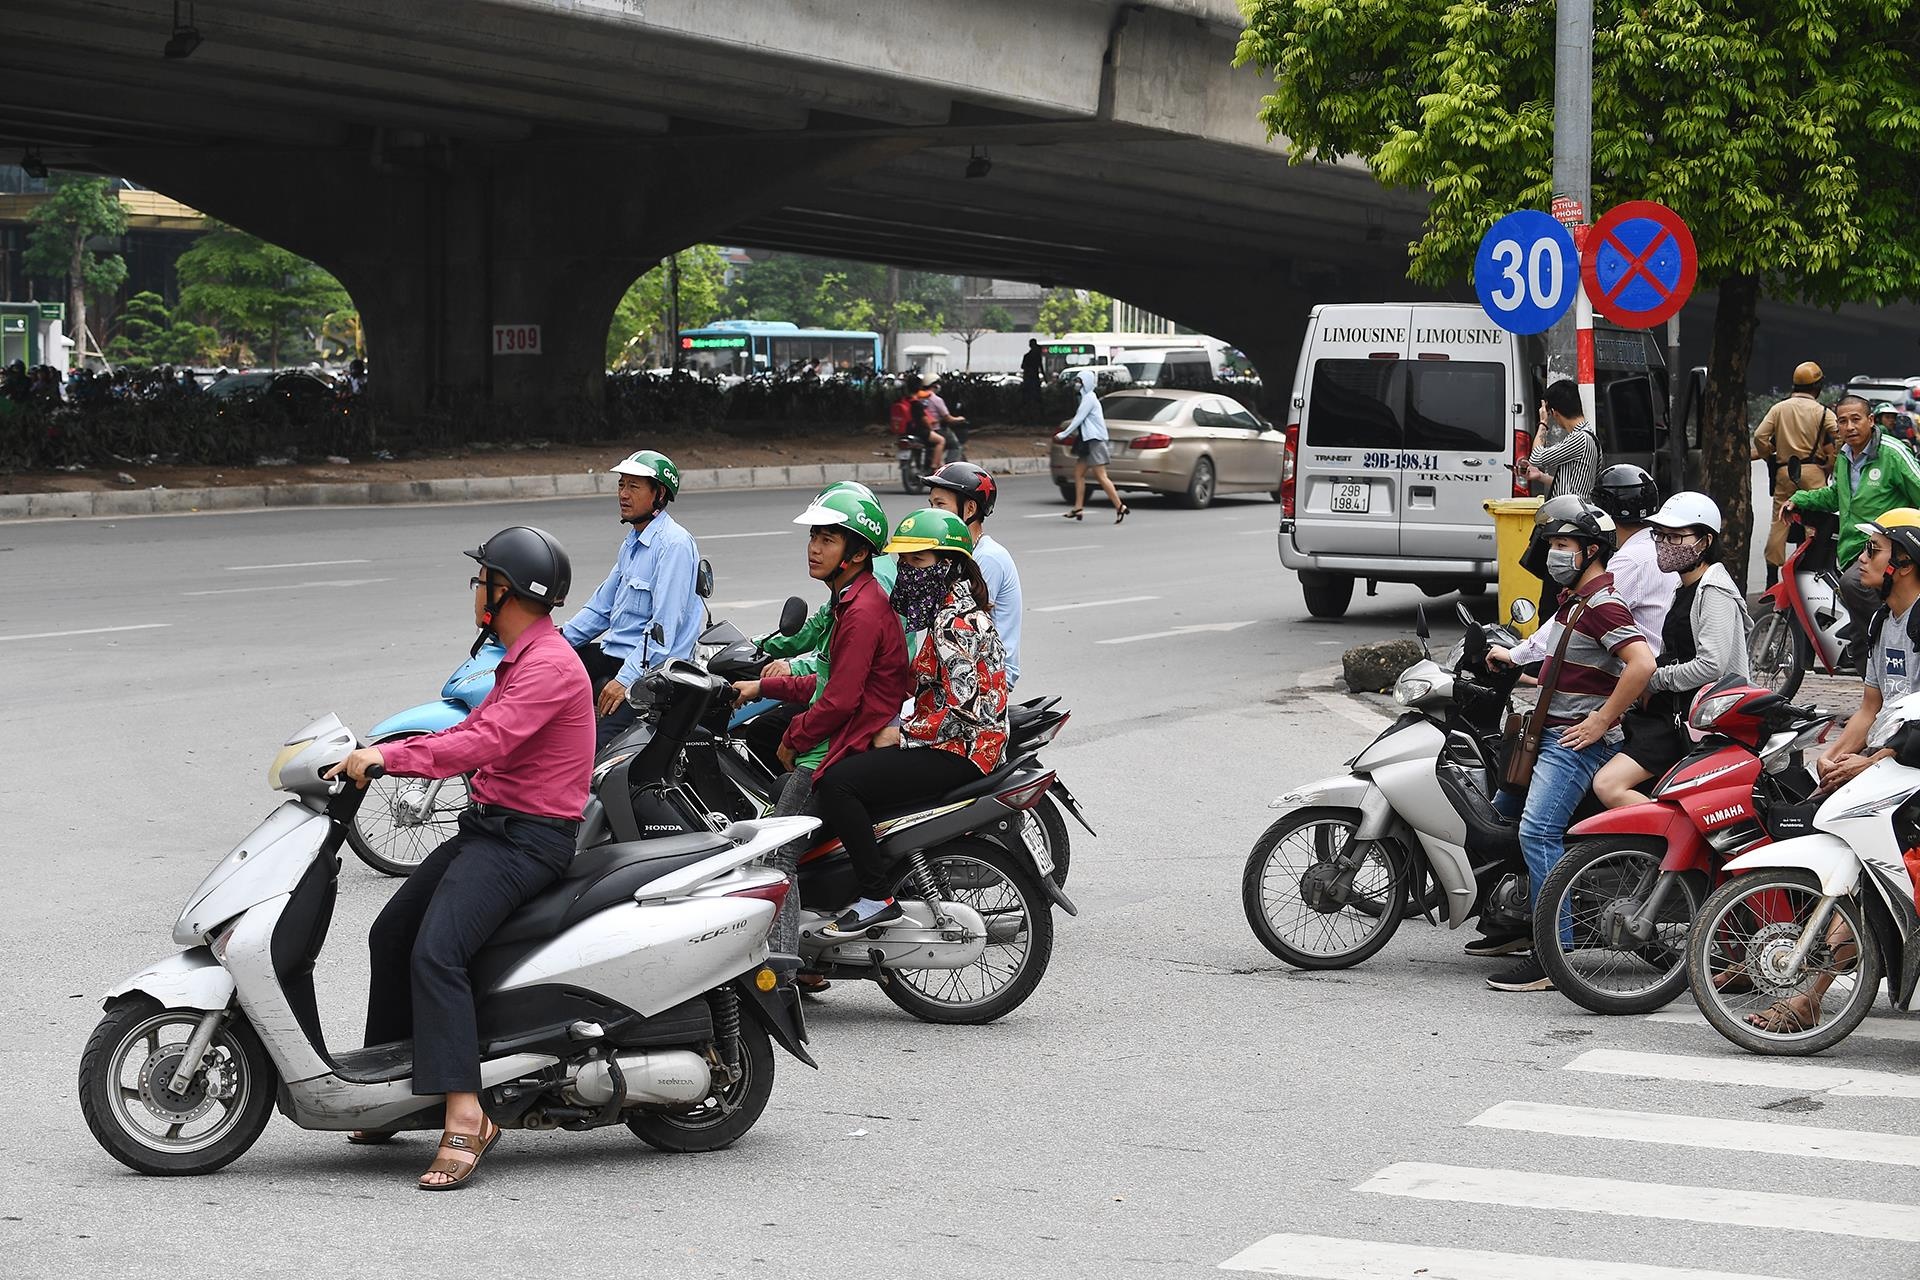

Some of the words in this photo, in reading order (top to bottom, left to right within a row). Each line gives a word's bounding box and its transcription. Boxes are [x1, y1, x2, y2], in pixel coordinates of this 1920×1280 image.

[1491, 237, 1563, 311] 30
[495, 327, 537, 351] T309
[1323, 327, 1405, 343] LIMOUSINE
[1416, 328, 1502, 344] LIMOUSINE
[1315, 454, 1352, 462] TRANSIT
[1363, 452, 1439, 471] 29B-198.41
[663, 468, 679, 487] Grab
[1418, 473, 1492, 482] TRANSIT
[1341, 485, 1360, 497] 29B
[1334, 498, 1366, 510] 198.41
[856, 512, 882, 536] Grab
[1703, 804, 1745, 825] YAMAHA
[732, 919, 747, 930] 110
